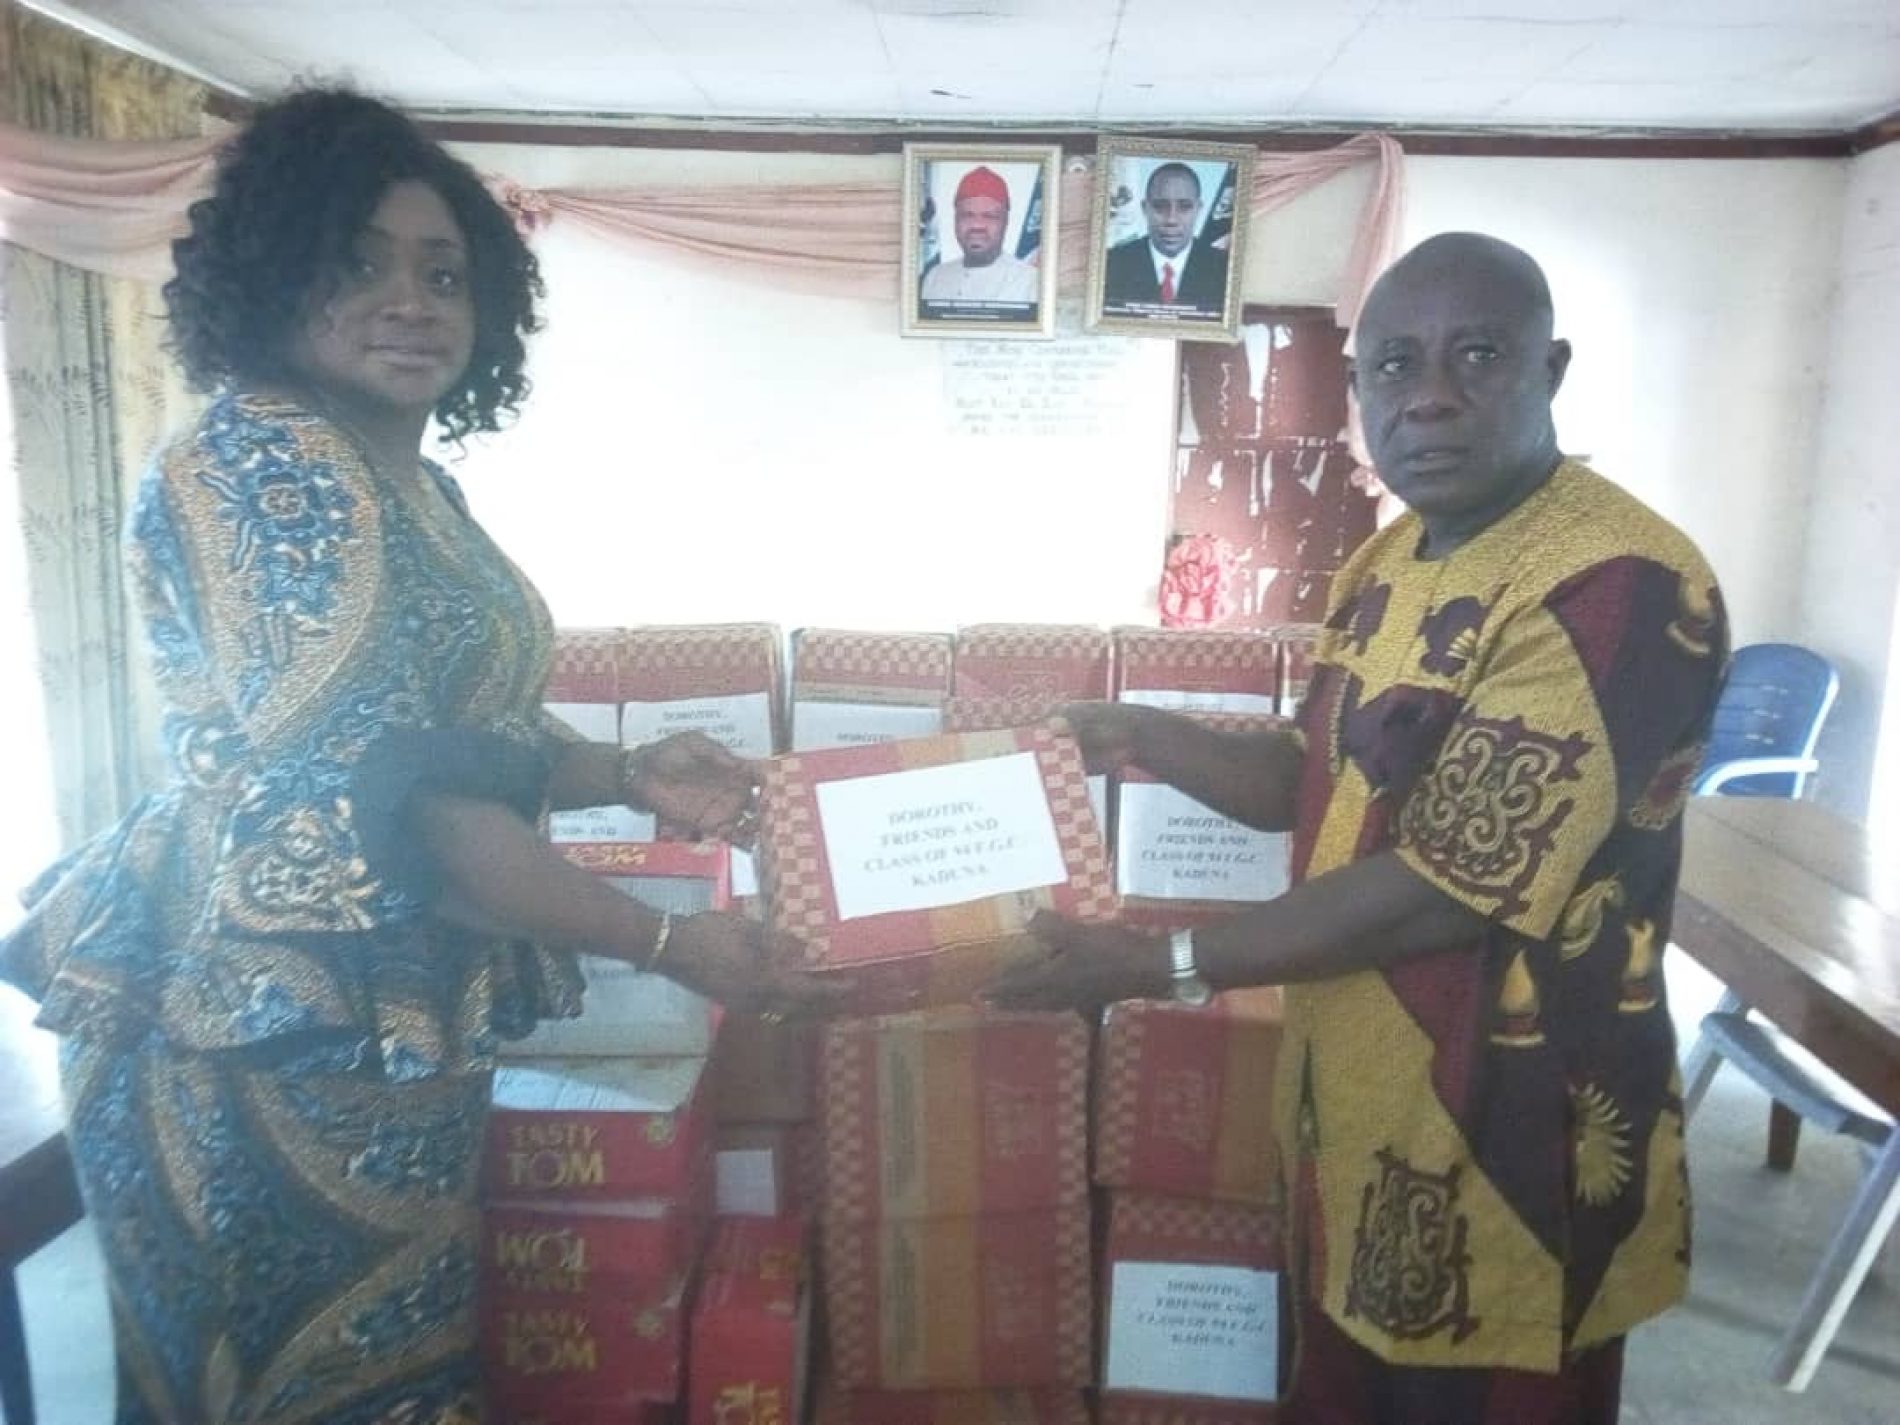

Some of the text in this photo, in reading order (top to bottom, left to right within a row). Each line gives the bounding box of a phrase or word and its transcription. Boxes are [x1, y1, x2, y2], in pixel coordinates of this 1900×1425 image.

[888, 801, 984, 826] DOROTHY,
[877, 817, 1000, 847] FRIENDS AND
[863, 854, 921, 872] CLASS
[924, 848, 948, 862] OF
[911, 863, 989, 888] KADUNA
[507, 1150, 605, 1188] TOM
